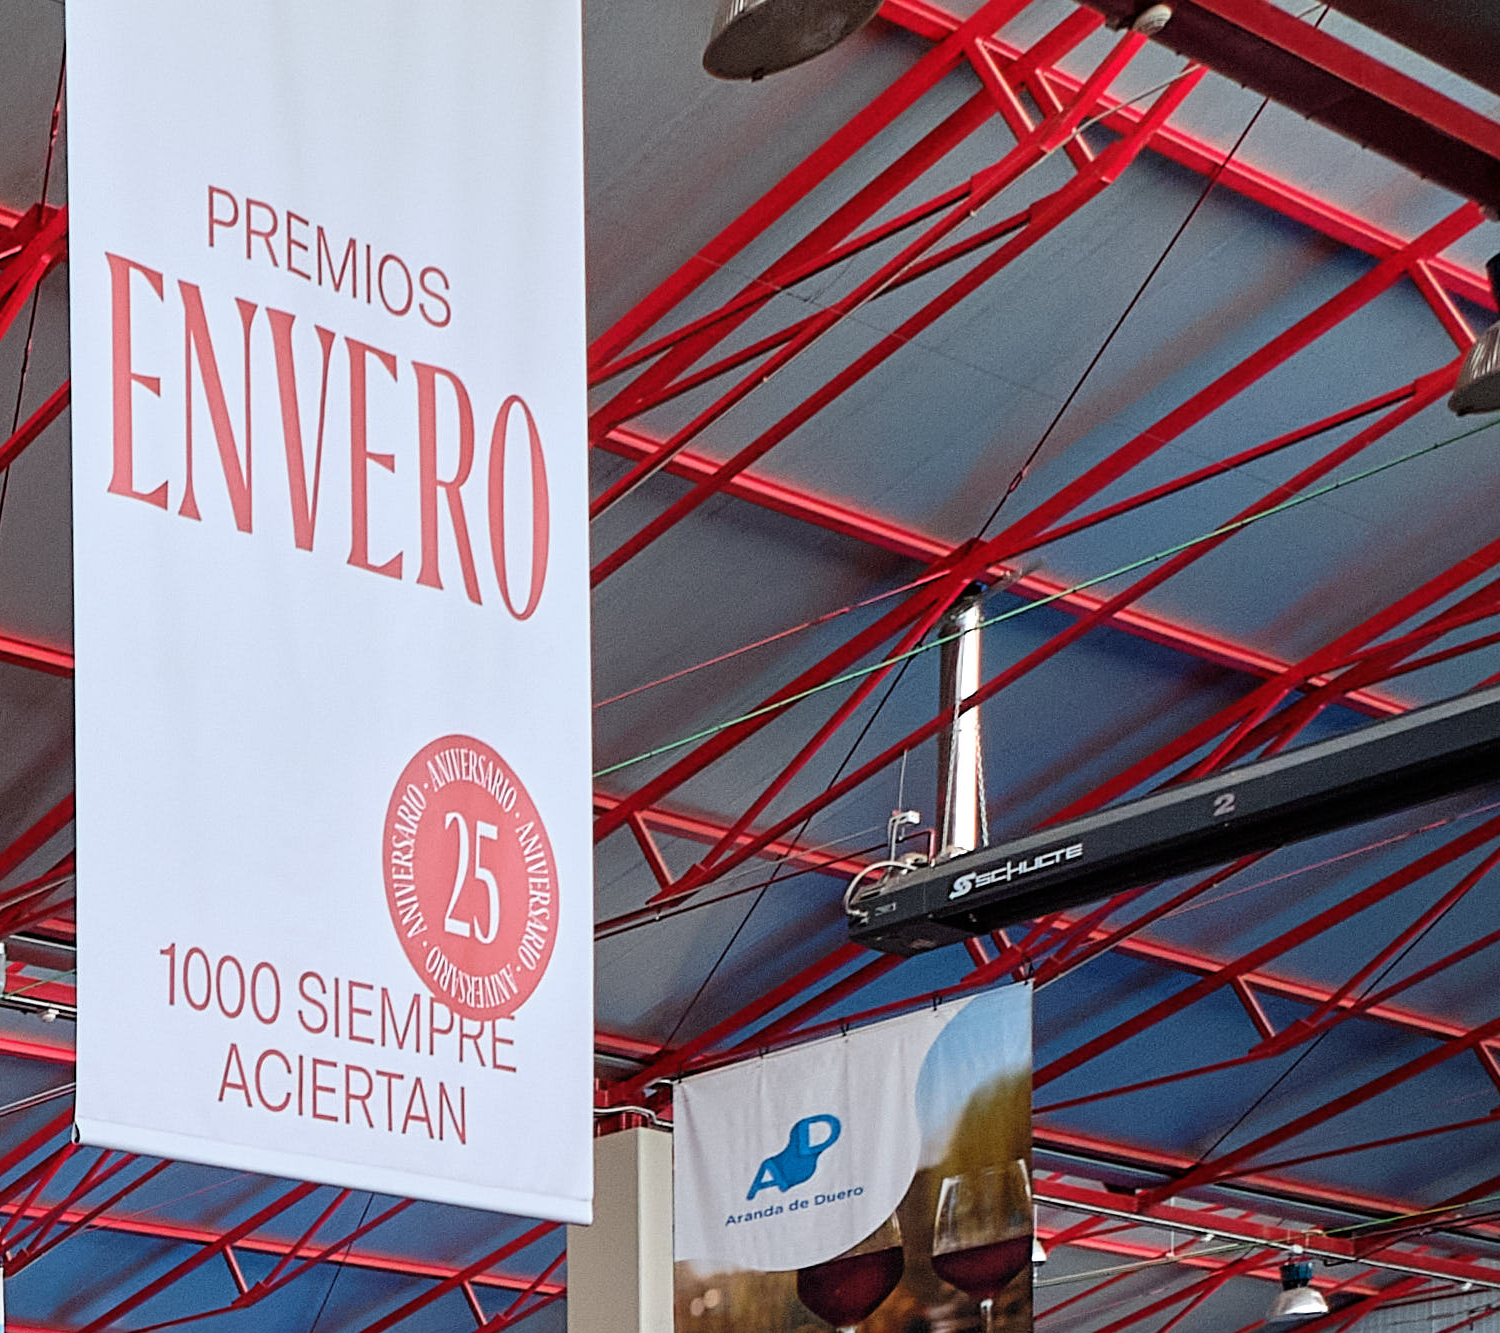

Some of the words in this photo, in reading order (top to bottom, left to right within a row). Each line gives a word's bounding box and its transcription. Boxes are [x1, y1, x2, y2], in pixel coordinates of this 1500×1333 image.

[206, 184, 452, 328] PREMIOS
[104, 250, 550, 622] ENVERO
[1213, 793, 1235, 816] 2
[444, 811, 499, 945] 25
[159, 942, 281, 1026] 1000
[298, 970, 518, 1074] SIEMPRE
[218, 1042, 467, 1145] ACIERTAN
[724, 1203, 784, 1228] Aranda
[788, 1198, 810, 1214] de
[812, 1184, 864, 1209] Duero
